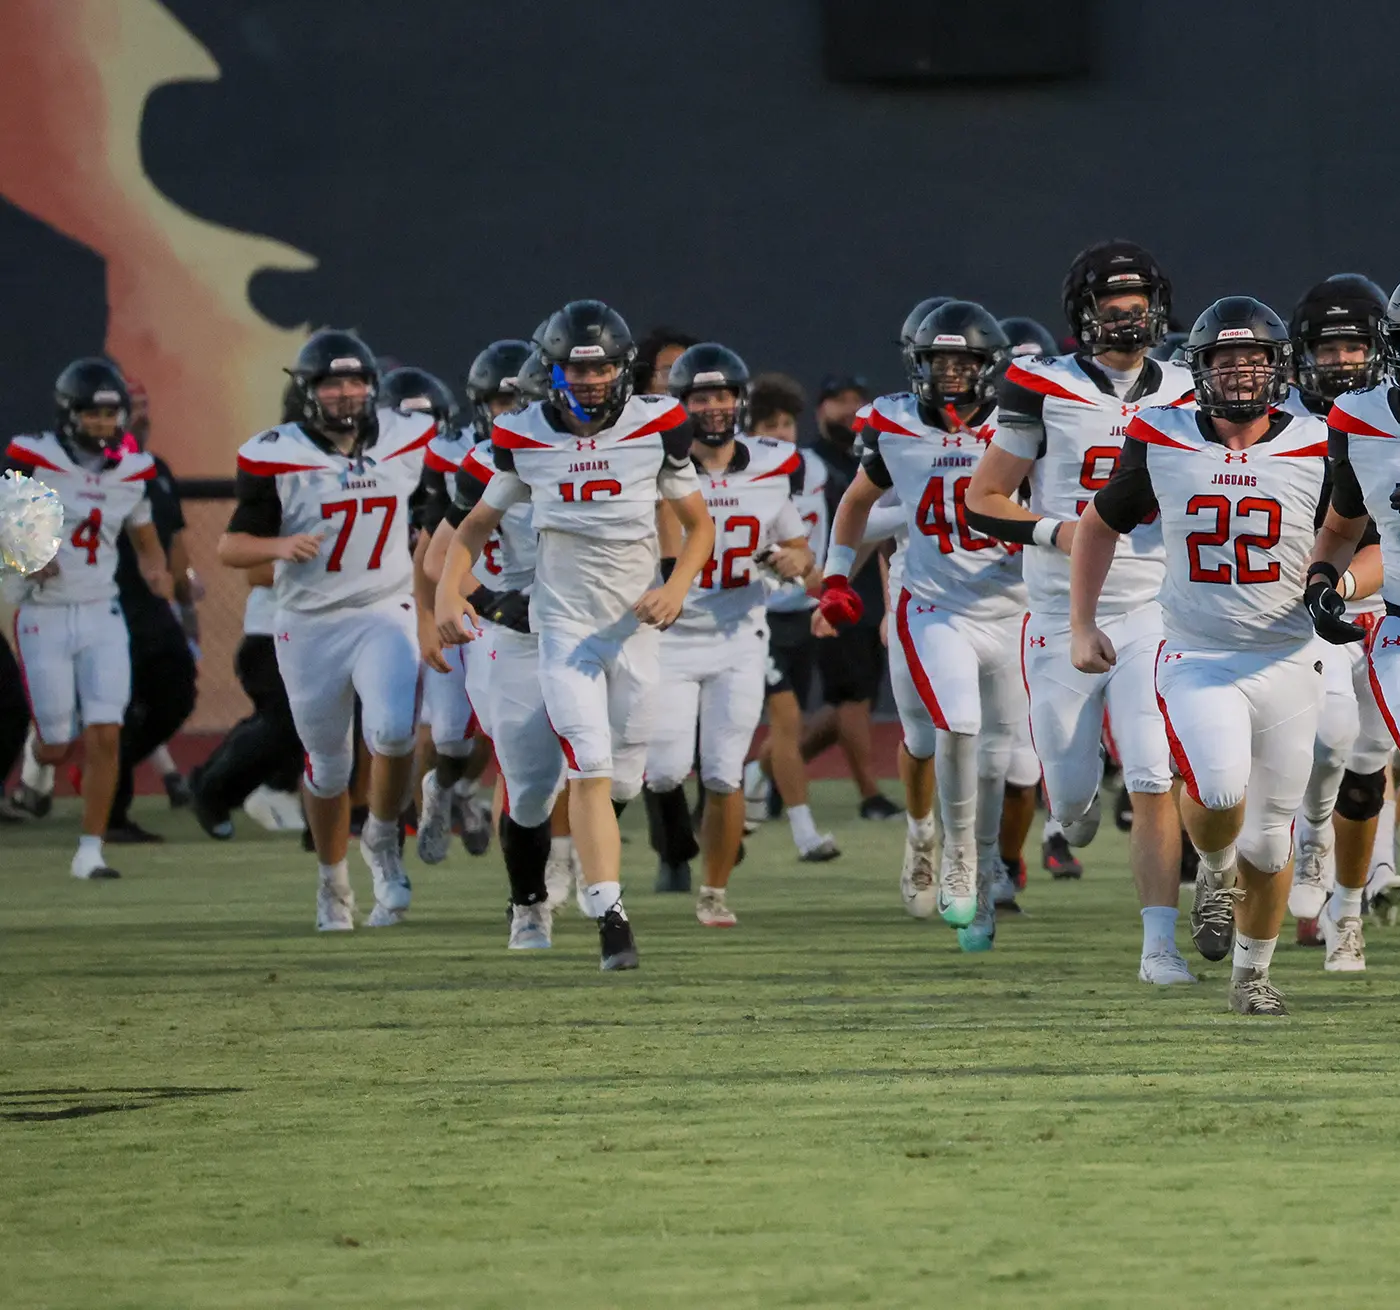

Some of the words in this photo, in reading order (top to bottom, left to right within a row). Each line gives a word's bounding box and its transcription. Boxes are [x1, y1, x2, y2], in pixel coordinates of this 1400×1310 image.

[1221, 329, 1249, 337] Riddell
[568, 460, 610, 473] JAGUARS
[931, 457, 973, 467] JAGUARS
[1211, 474, 1257, 487] JAGUARS
[72, 508, 101, 565] 4
[321, 496, 398, 572] 77
[1186, 494, 1282, 585] 22
